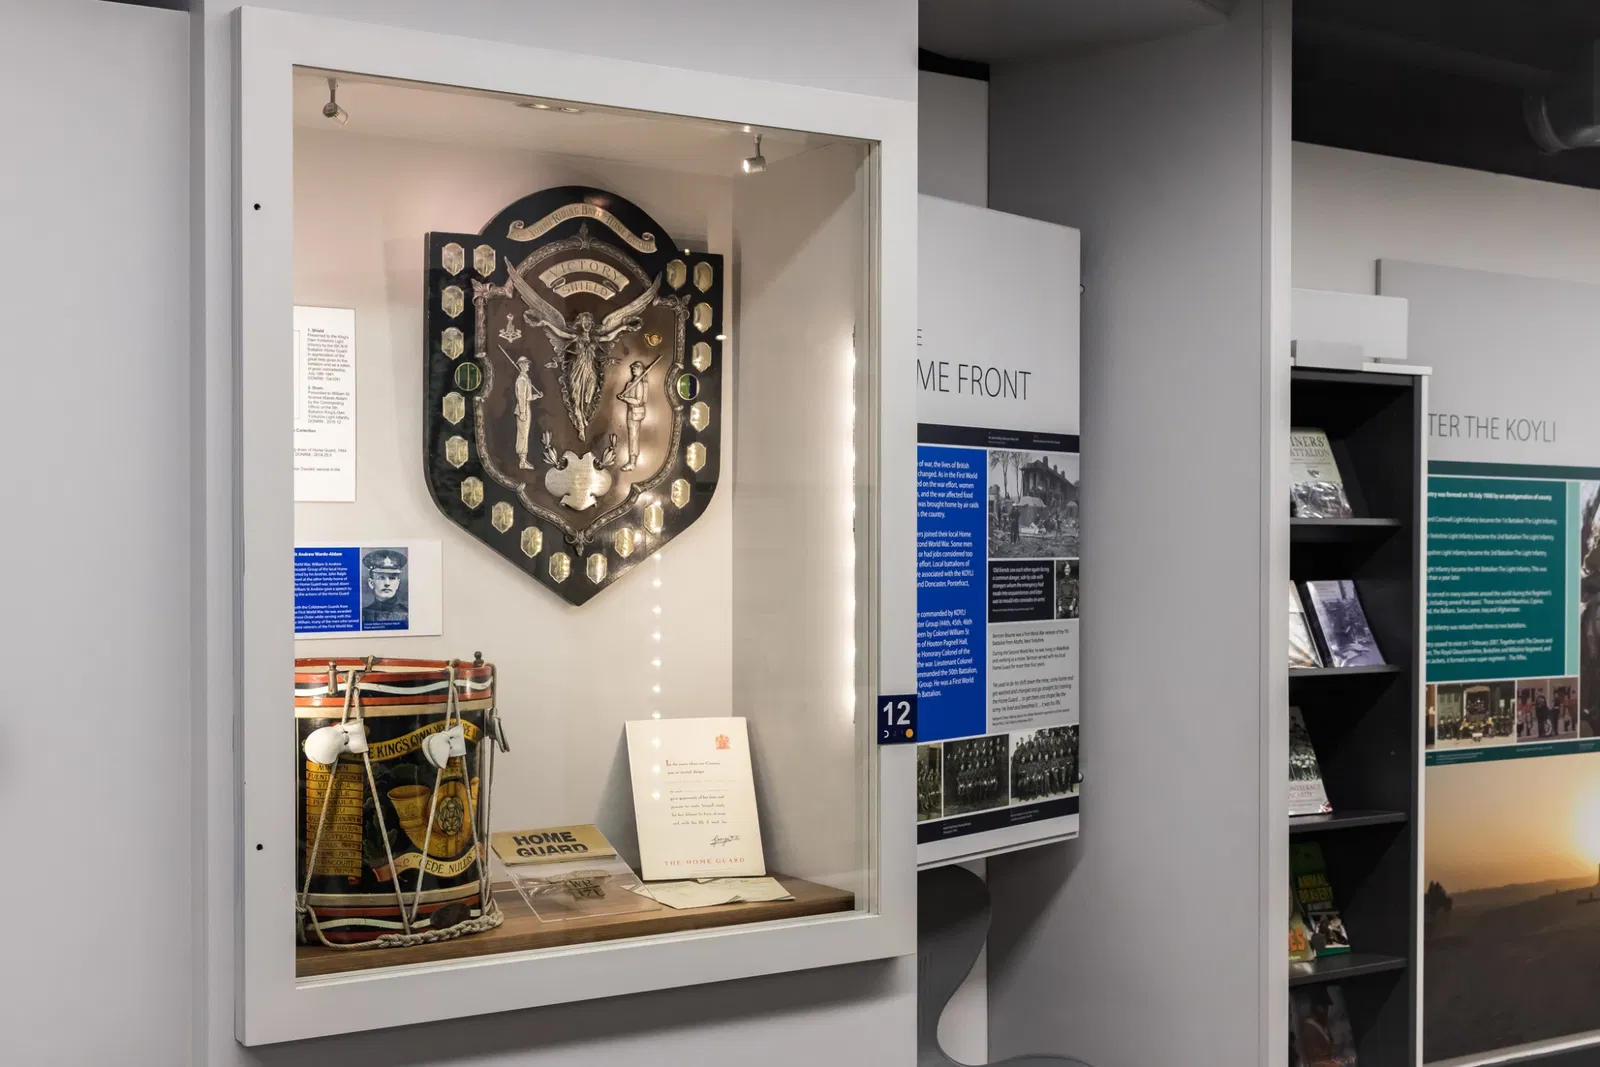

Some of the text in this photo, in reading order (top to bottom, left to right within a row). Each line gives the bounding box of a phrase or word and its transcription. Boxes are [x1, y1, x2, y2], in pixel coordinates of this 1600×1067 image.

[552, 206, 580, 224] RIDING
[549, 260, 623, 281] VICTORY
[562, 282, 608, 296] SHIELD
[917, 359, 1032, 400] ME FRONT
[1428, 413, 1556, 442] TER THE KOYLI
[1290, 436, 1325, 447] INERS'
[1290, 448, 1330, 458] ATTALION
[927, 501, 944, 509] brought
[883, 701, 910, 726] 12
[377, 738, 410, 756] KING'S
[513, 832, 576, 846] HOME
[516, 844, 588, 857] GUARD
